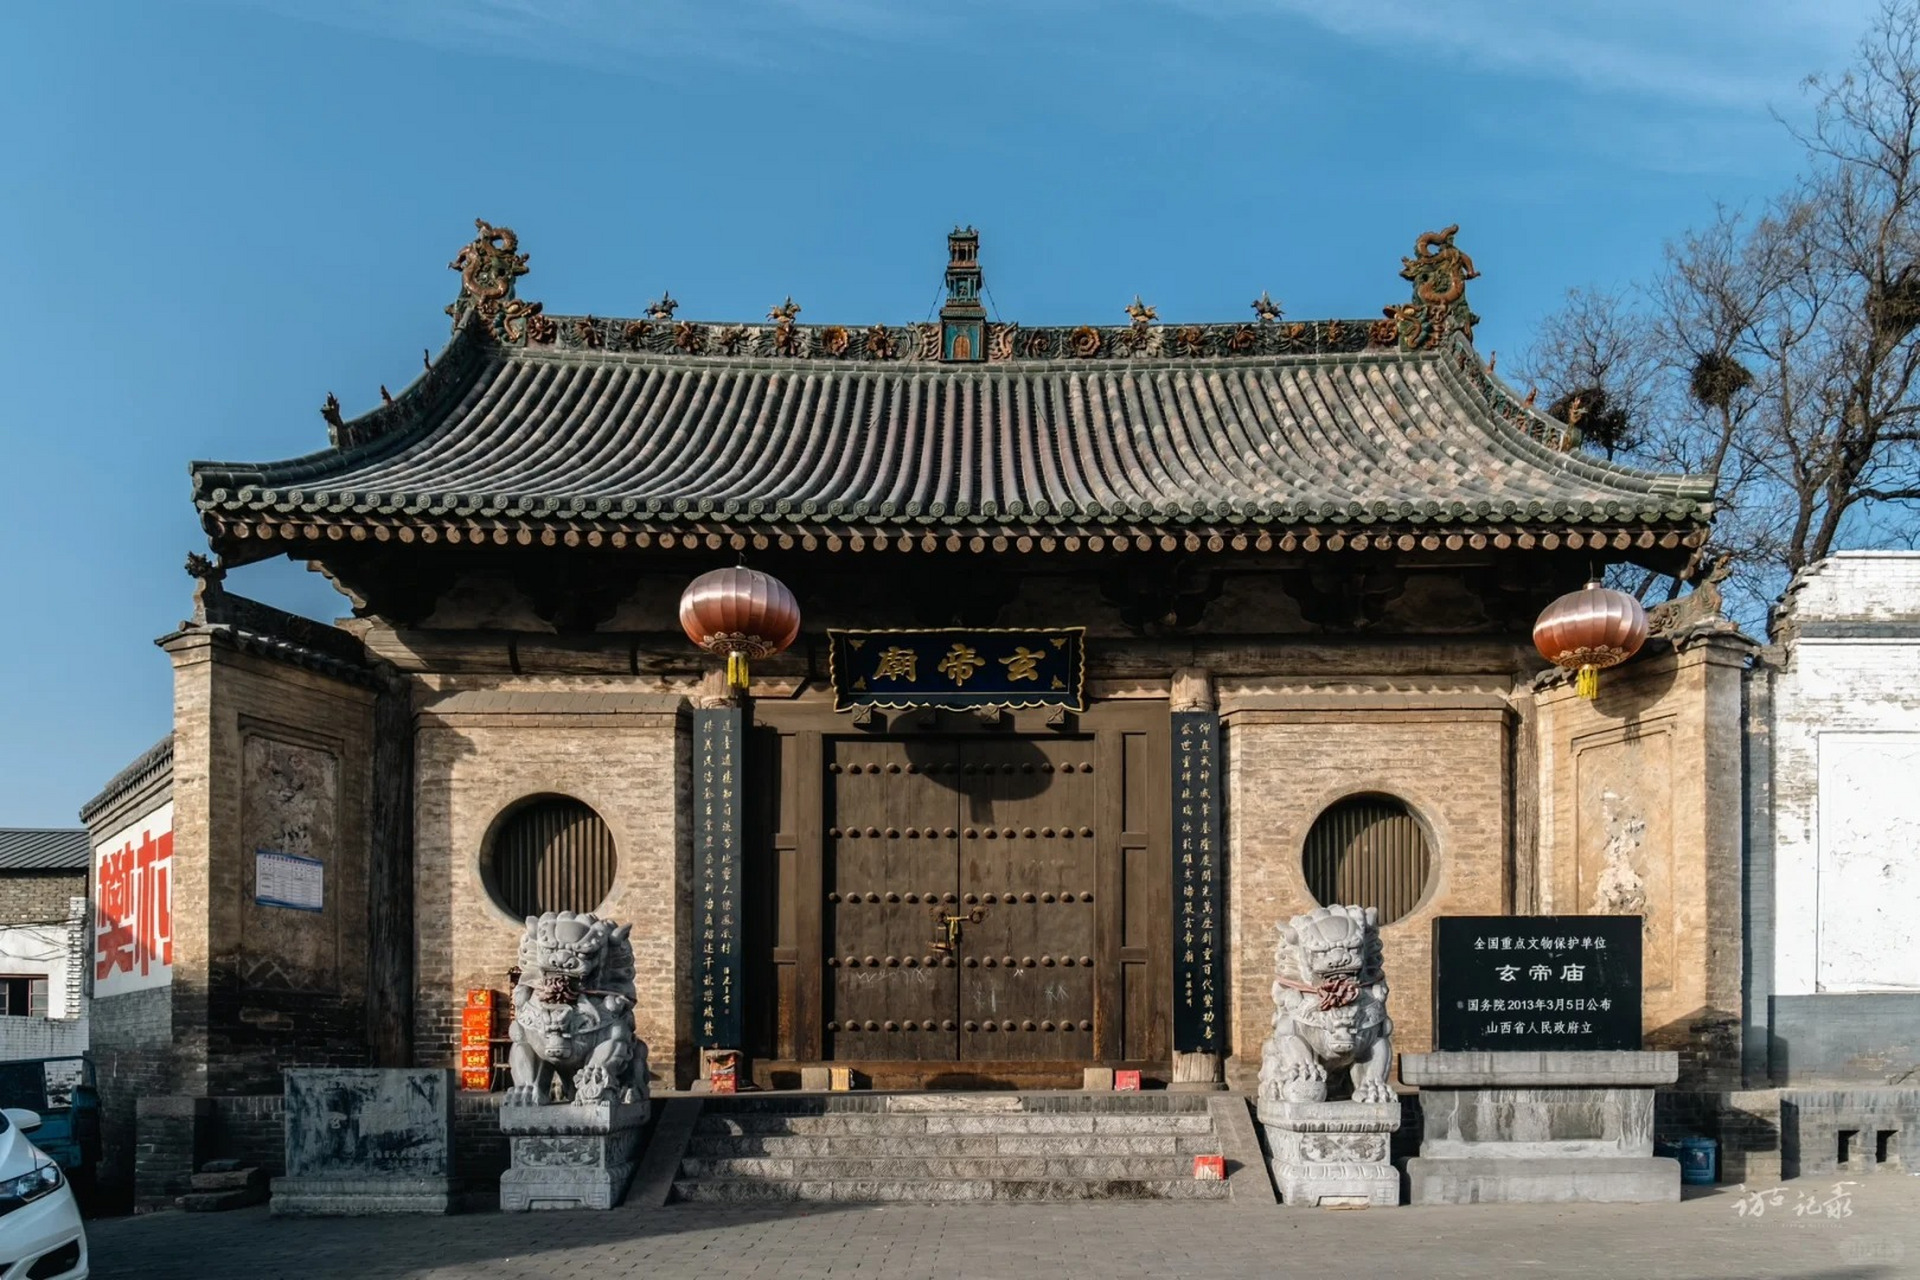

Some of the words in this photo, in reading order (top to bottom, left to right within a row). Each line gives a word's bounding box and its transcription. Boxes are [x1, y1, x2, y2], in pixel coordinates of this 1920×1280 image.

[96, 830, 173, 981] 樊村
[1474, 936, 1607, 951] 全国重点文物保护单位
[1495, 963, 1586, 982] 玄帝庙
[1467, 998, 1612, 1012] 国务院2013年3月5日公布
[1486, 1020, 1593, 1035] 山西省人民政府立
